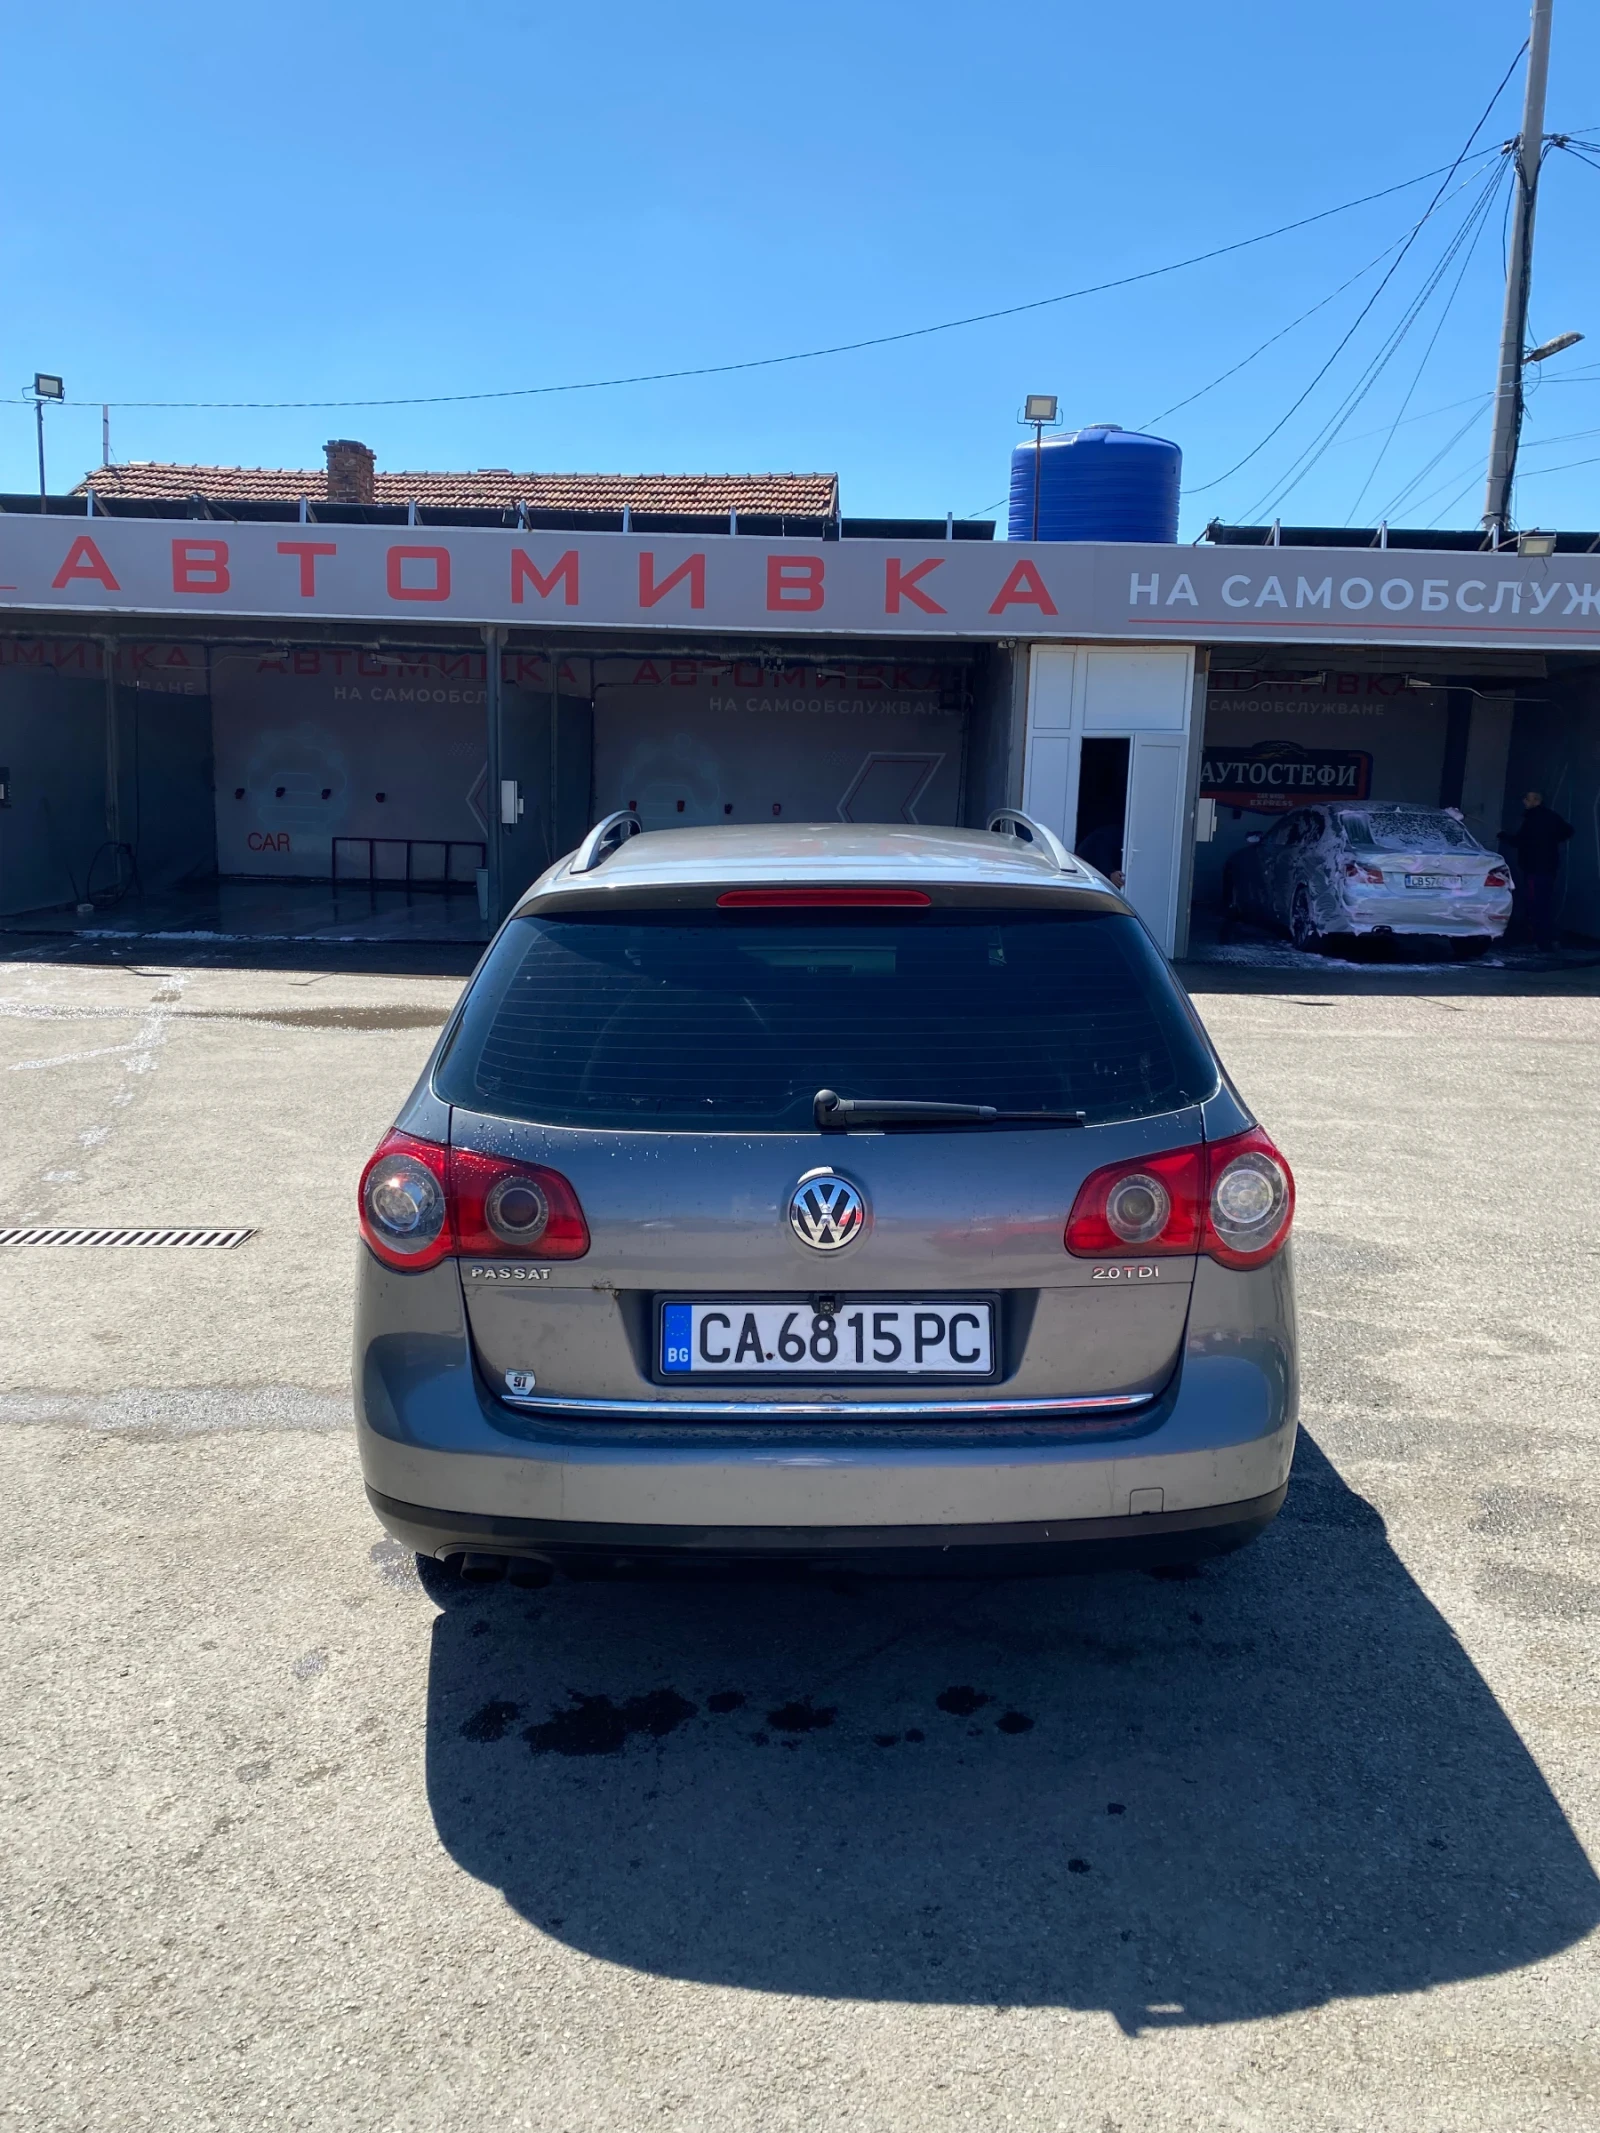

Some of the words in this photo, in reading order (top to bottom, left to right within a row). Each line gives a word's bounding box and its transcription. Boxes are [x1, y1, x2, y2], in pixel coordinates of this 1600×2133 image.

[52, 535, 1059, 616] АВТОМИВКА
[1129, 572, 1199, 606] НА
[333, 687, 363, 702] НА
[709, 697, 736, 712] НА
[1209, 700, 1385, 716] САМООБСЛУЖВАНЕ
[1200, 761, 1358, 787] АУТОСТЕФИ
[247, 832, 290, 852] CAR
[471, 1266, 552, 1280] PASSAT
[667, 1347, 689, 1363] BG
[513, 1376, 527, 1388] 91
